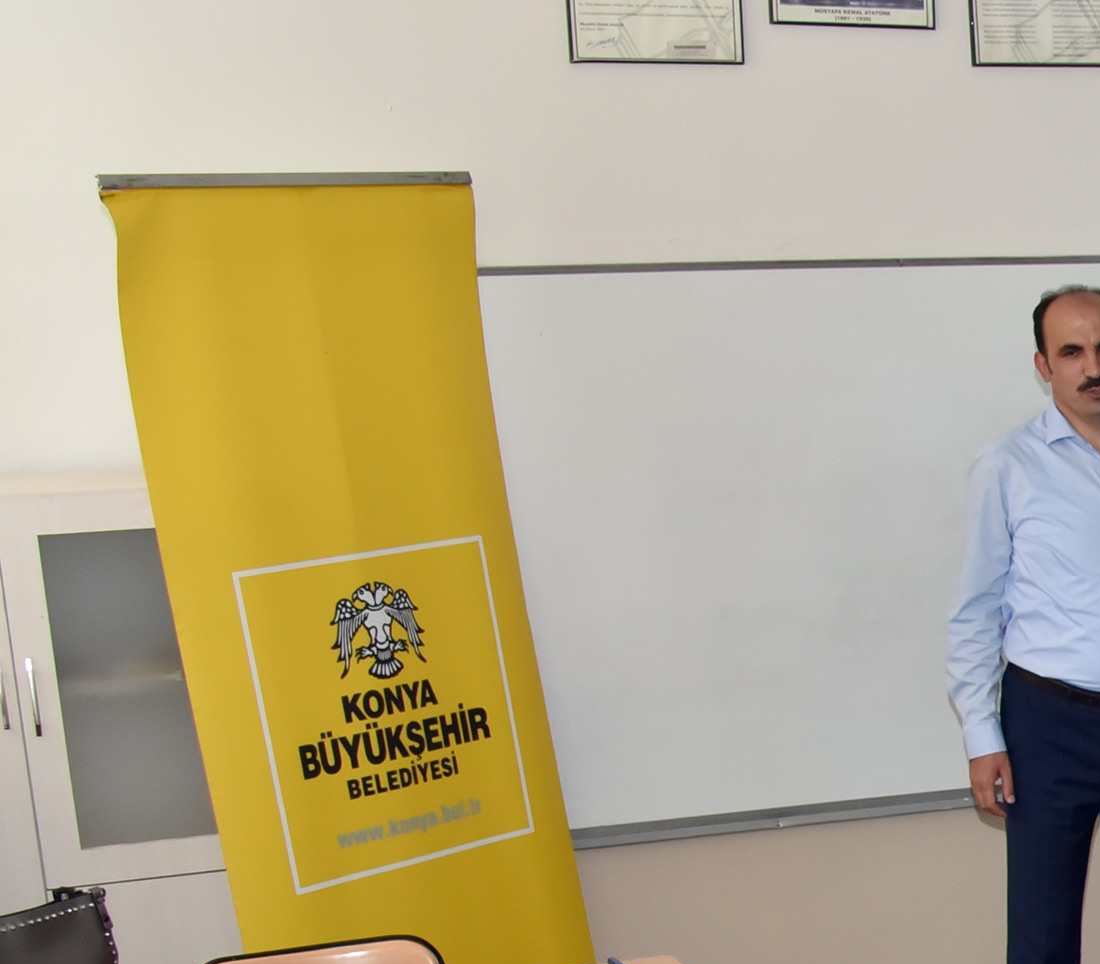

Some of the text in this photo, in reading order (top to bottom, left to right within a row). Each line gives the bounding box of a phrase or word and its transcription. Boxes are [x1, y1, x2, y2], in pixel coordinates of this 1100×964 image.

[341, 679, 438, 723] KONYA
[298, 703, 492, 780] BÜYÜKŞEHİR
[347, 751, 459, 800] BELEDİYESİ
